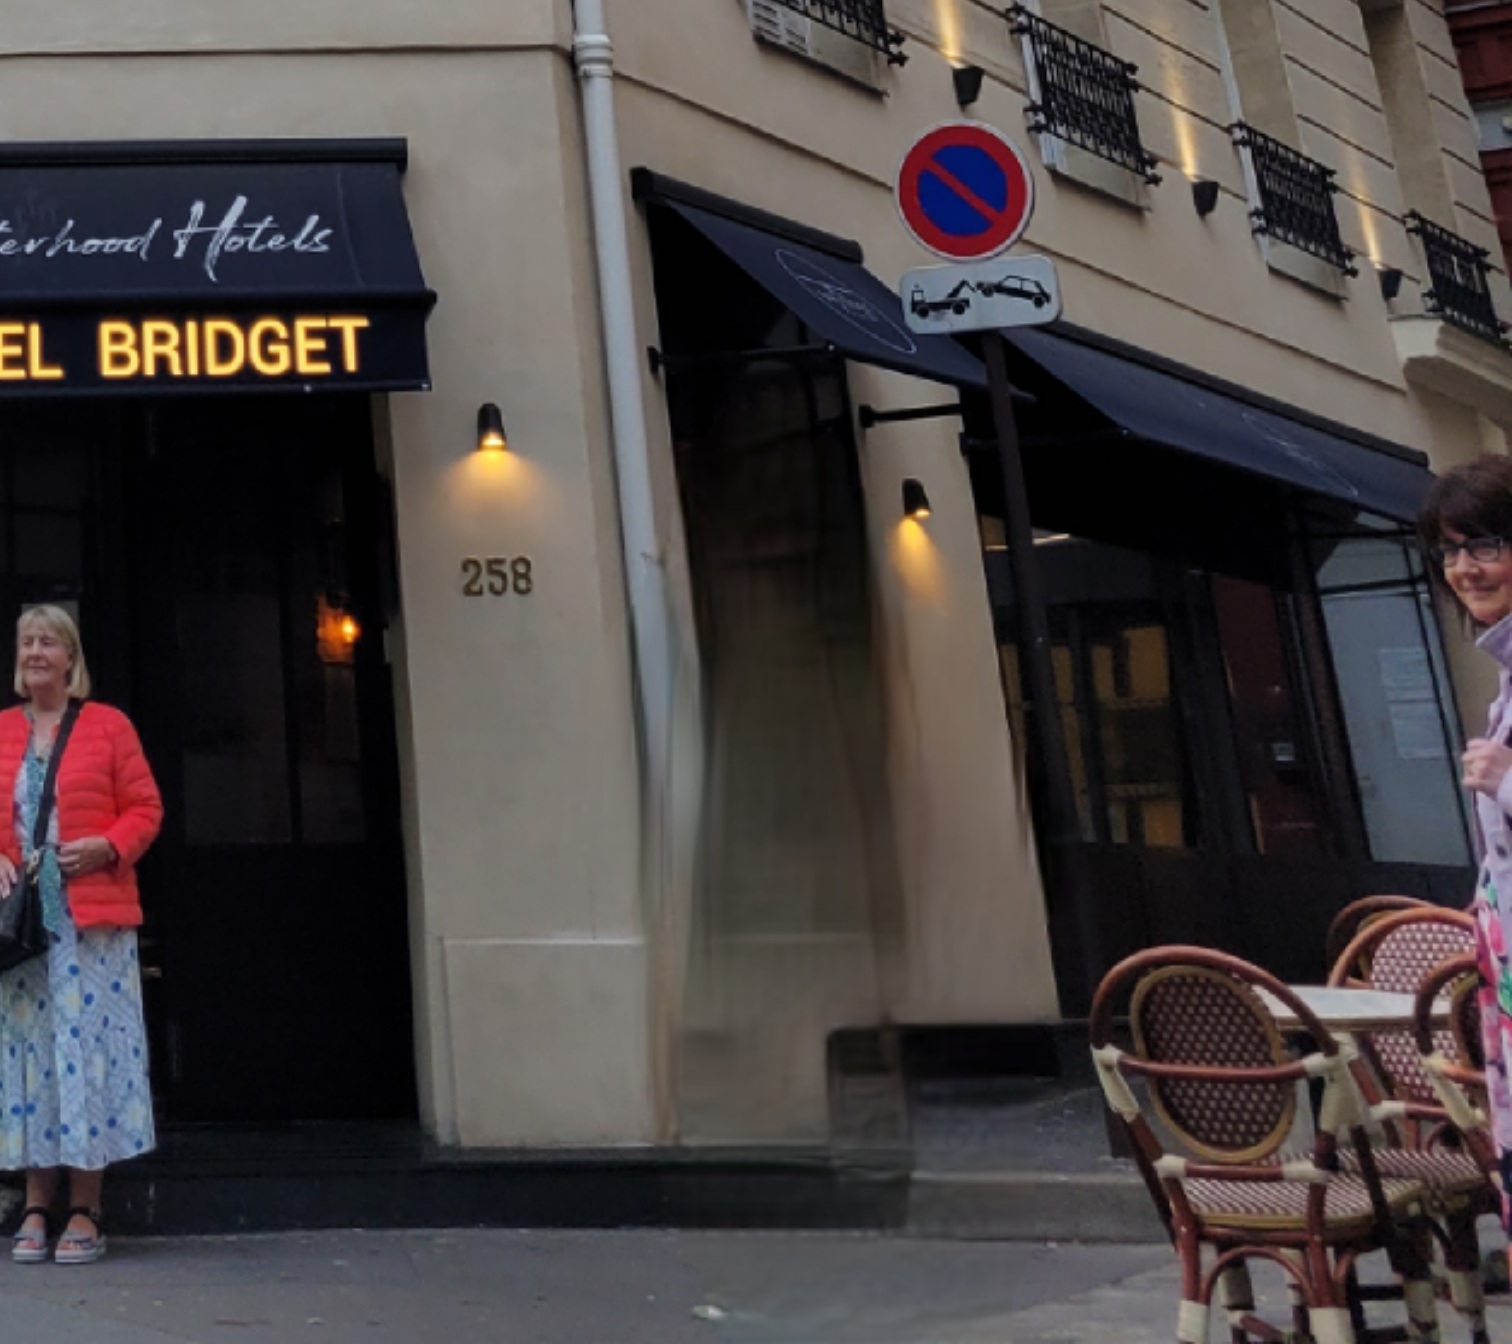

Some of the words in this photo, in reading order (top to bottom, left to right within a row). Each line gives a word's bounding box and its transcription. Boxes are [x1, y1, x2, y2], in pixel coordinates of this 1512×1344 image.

[173, 194, 333, 282] Hotels
[97, 316, 370, 377] BRIDGET
[461, 557, 533, 597] 258
